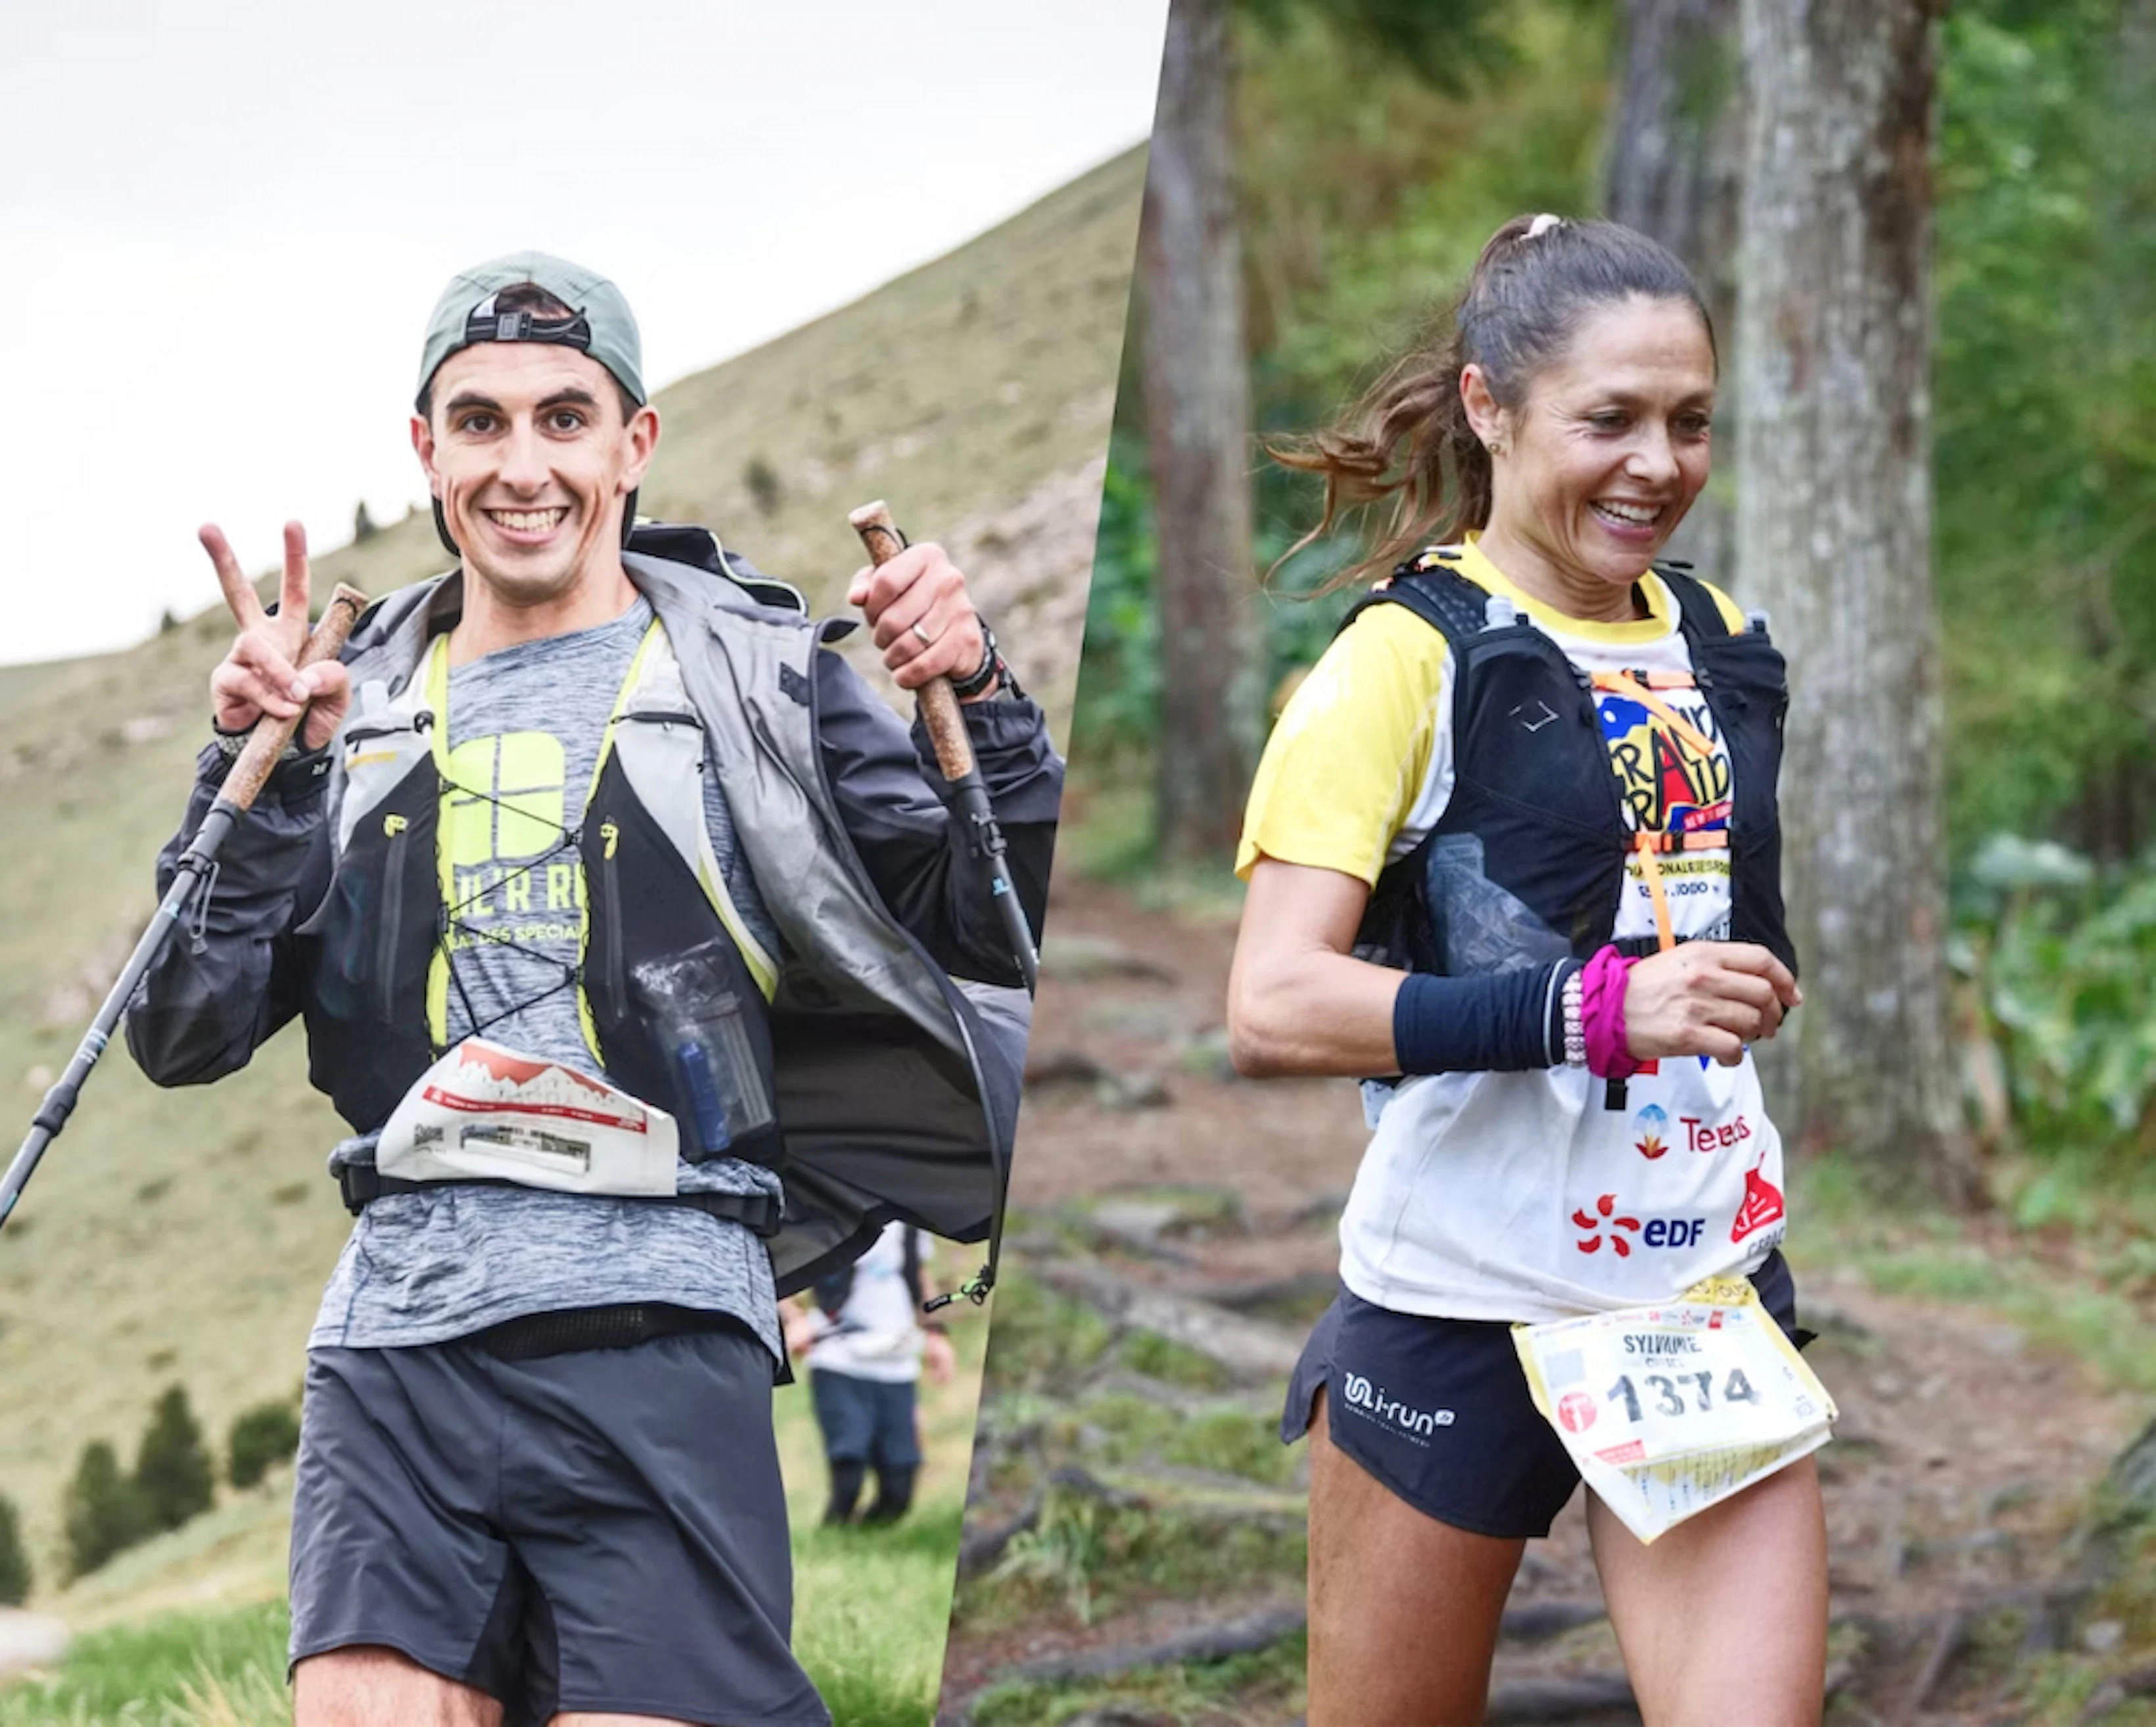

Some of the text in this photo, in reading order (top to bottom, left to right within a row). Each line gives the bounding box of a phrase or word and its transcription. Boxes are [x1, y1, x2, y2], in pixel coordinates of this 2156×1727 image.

[514, 922, 582, 942] SPECIA
[1374, 1387, 1435, 1436] i-run
[1607, 1367, 1762, 1423] 1374
